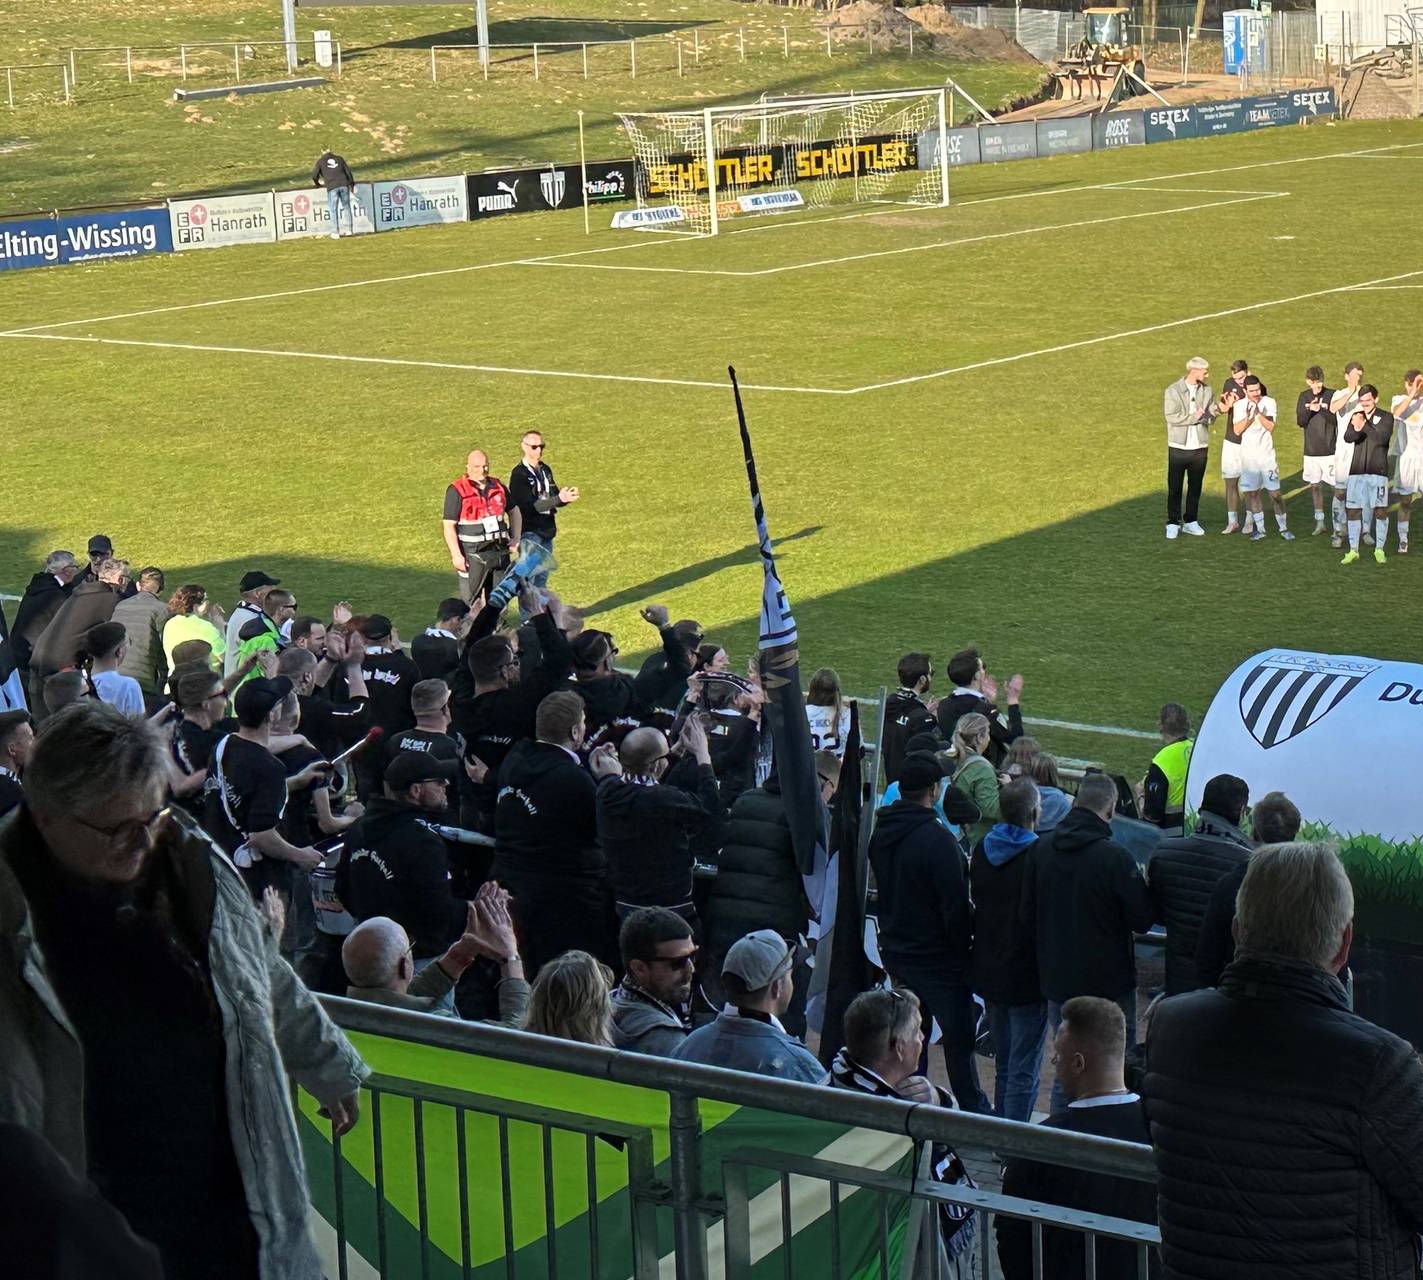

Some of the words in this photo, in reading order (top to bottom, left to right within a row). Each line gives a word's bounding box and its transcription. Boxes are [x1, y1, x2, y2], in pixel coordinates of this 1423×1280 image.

[1293, 91, 1331, 109] SETEX
[1150, 109, 1190, 128] SETEX
[1249, 108, 1270, 123] TEAM
[1105, 118, 1132, 137] ROSE
[409, 195, 460, 212] Hanrath
[478, 194, 512, 212] PUMA
[211, 213, 267, 232] Hanrath
[313, 205, 367, 222] Harth
